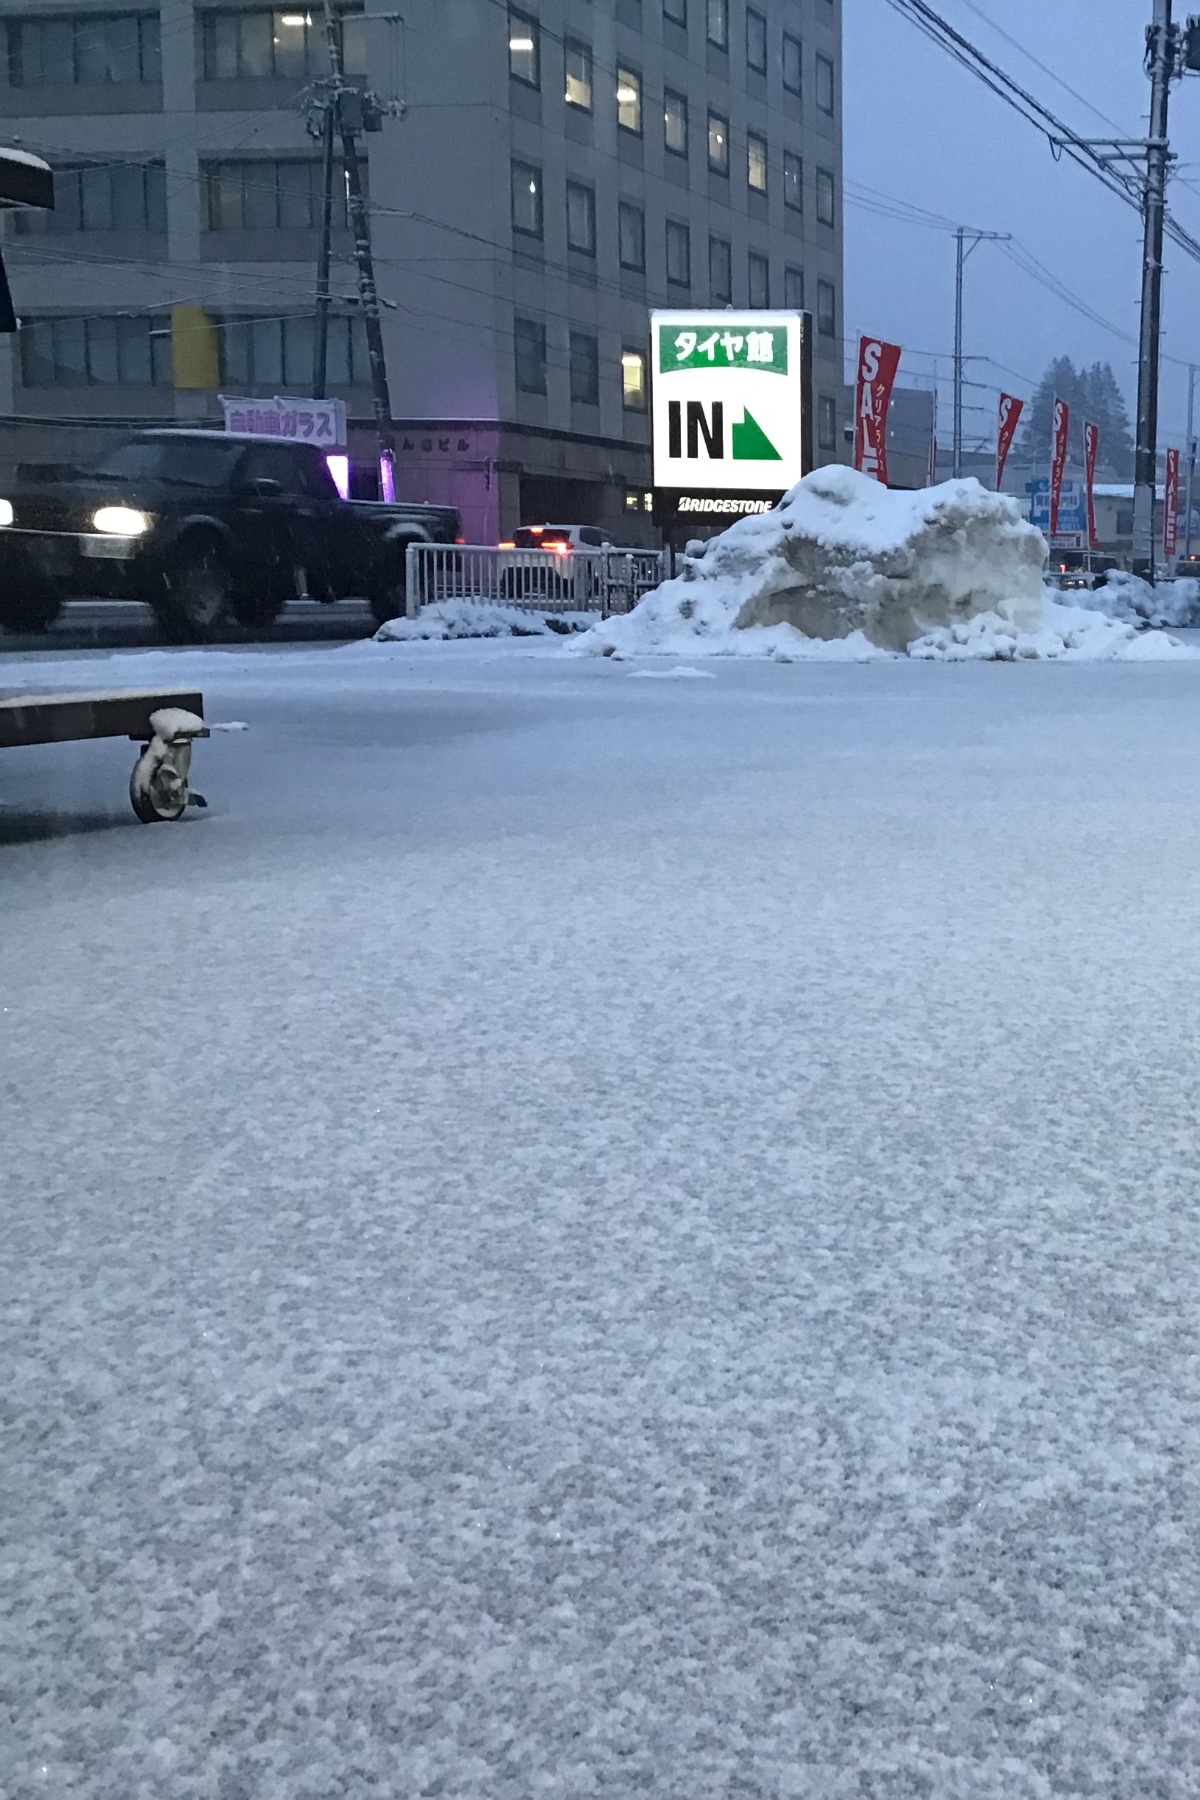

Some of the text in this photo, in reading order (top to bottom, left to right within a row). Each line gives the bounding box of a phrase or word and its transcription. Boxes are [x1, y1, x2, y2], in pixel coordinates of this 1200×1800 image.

[674, 331, 774, 362] タイヤ館
[229, 409, 333, 437] 自動車ガラス
[668, 400, 724, 460] IN
[677, 496, 773, 514] BRIDGESTONE
